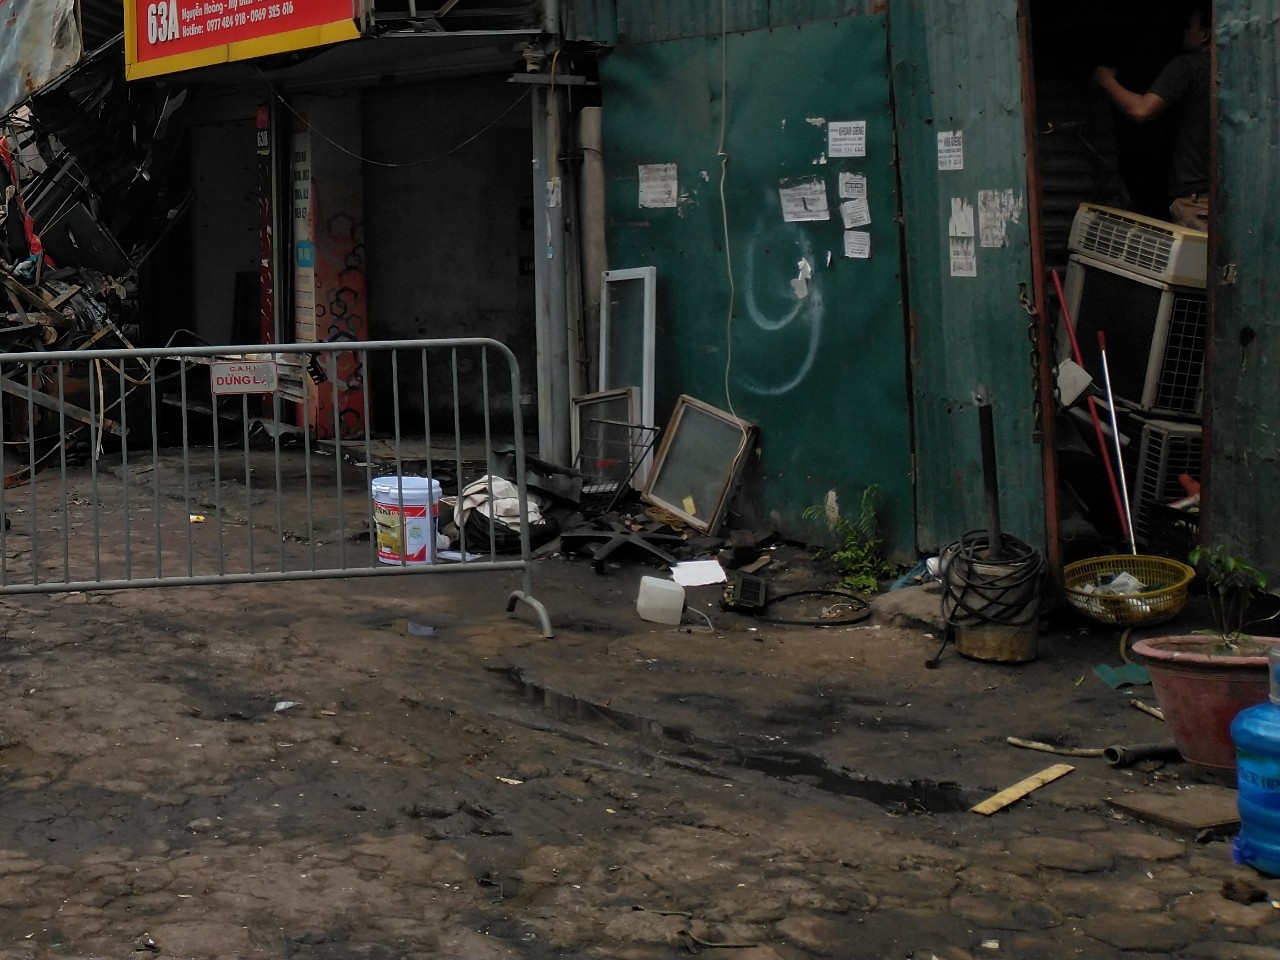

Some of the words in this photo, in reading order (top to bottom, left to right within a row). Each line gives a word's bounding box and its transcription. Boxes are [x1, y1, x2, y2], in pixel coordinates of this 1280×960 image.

[181, 3, 203, 22] Nguyễn
[203, 0, 223, 16] Hoàng
[182, 25, 204, 38] Hotline:
[206, 17, 221, 32] 0977
[250, 8, 267, 23] 0969
[216, 373, 251, 386] DỪNG
